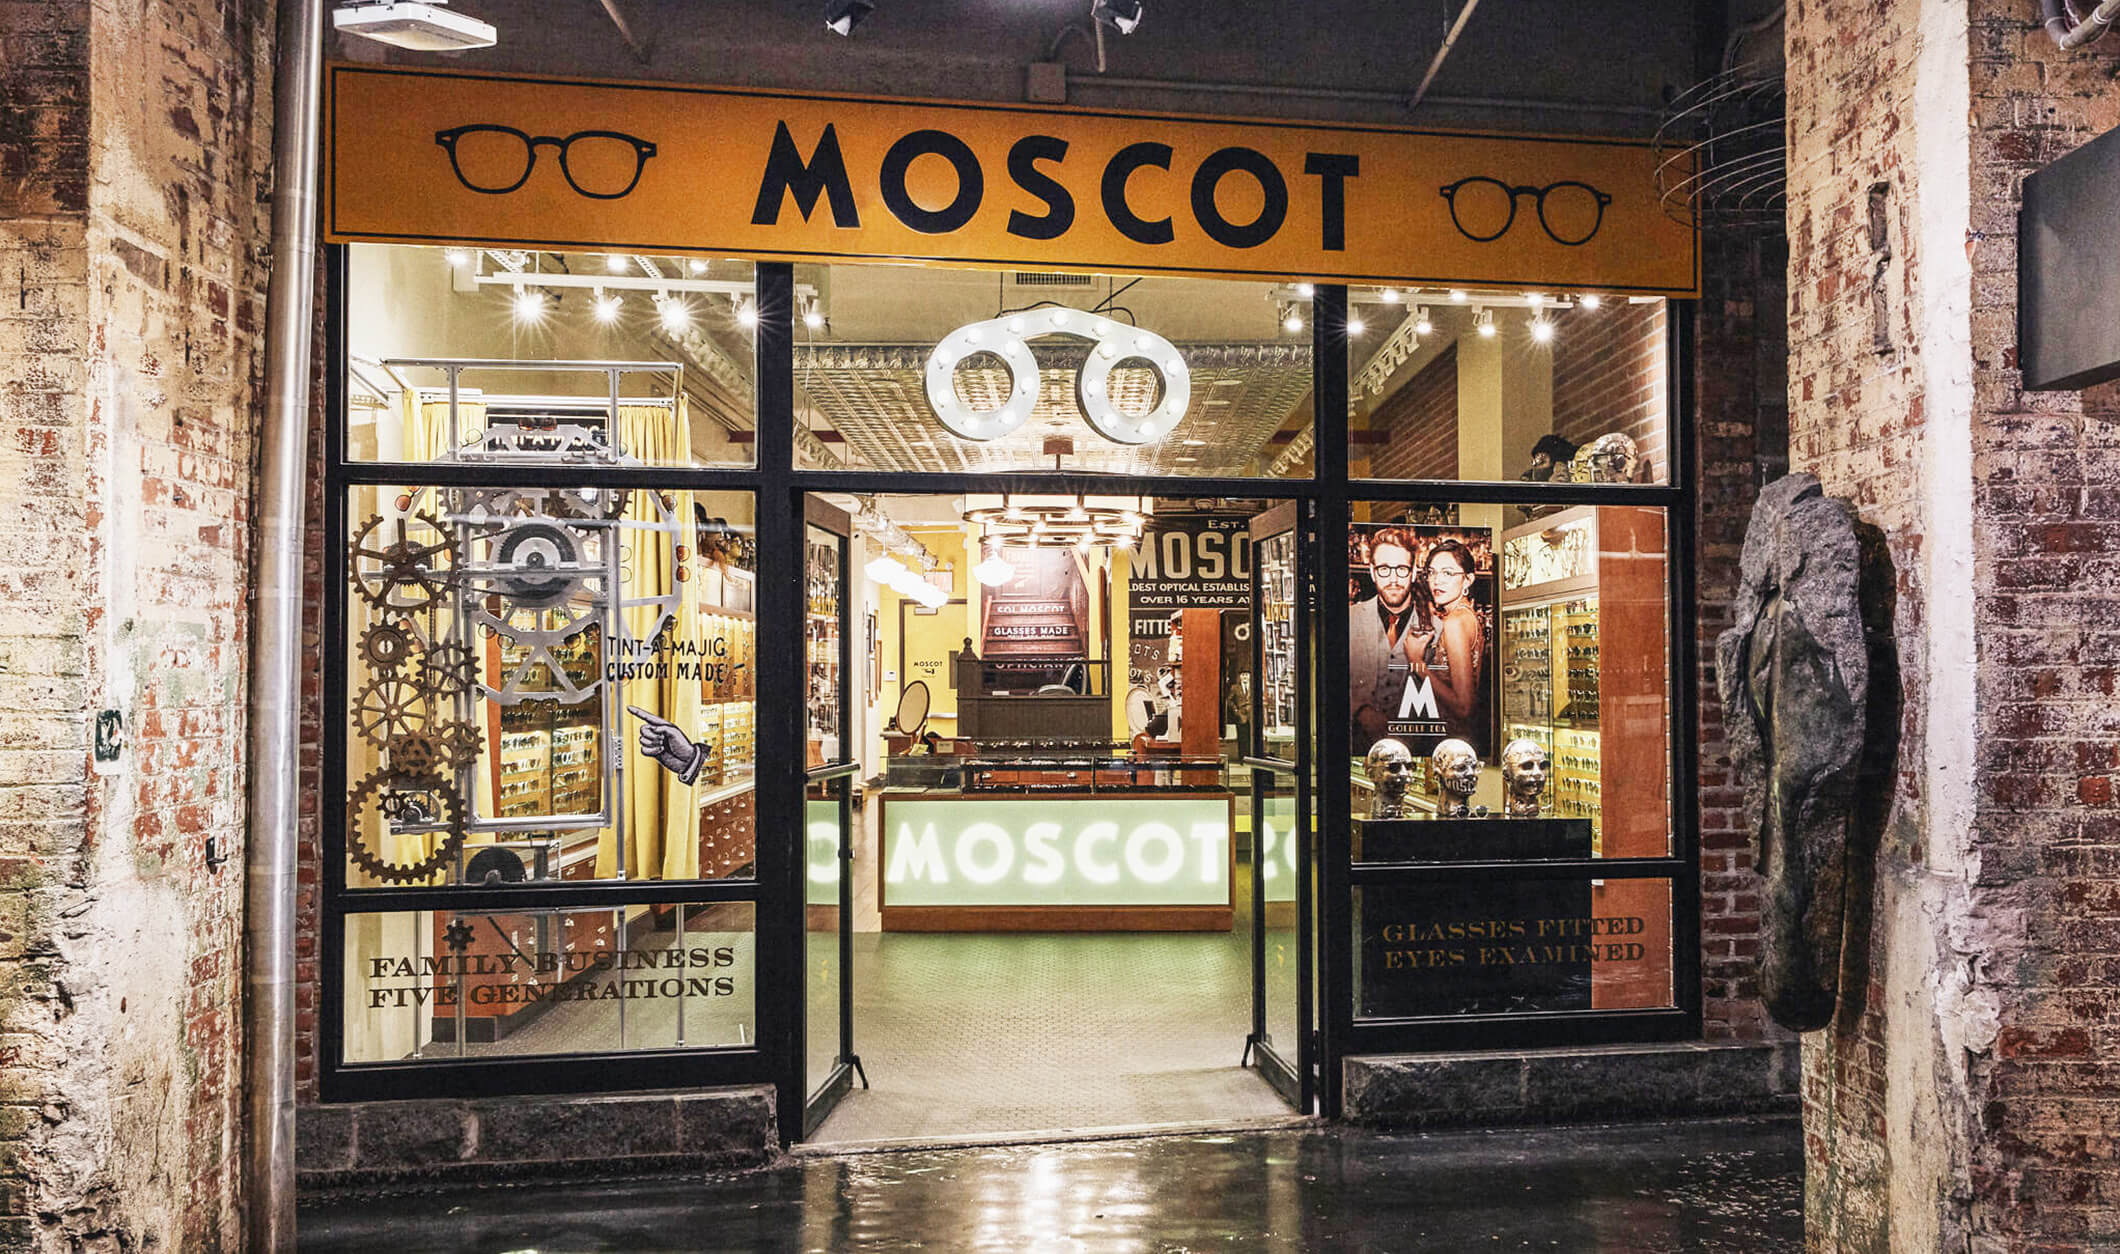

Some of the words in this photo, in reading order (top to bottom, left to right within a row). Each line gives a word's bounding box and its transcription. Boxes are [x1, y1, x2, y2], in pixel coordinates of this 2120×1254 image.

[751, 119, 1359, 251] MOSCOT
[1140, 596, 1173, 604] OVER
[1176, 595, 1188, 604] 16
[1191, 596, 1234, 604] YEARS
[1159, 583, 1200, 592] OPTICAL
[994, 626, 1036, 636] GLASSES
[1040, 626, 1068, 635] MADE
[607, 636, 726, 657] TINT-A-MAJIG
[606, 662, 668, 682] CUSTOM
[676, 662, 727, 683] MADE
[913, 660, 943, 668] MOSCOT
[1397, 675, 1440, 718] M
[885, 820, 1229, 884] MOSCOT
[1382, 919, 1526, 943] GLASSES
[1537, 916, 1645, 938] FITTED
[369, 953, 523, 978] FAMILY
[532, 946, 735, 974] BUSINESS
[1384, 948, 1465, 969] EYES
[1478, 942, 1646, 966] EXAMINED
[368, 985, 458, 1008] FIVE
[470, 976, 735, 1006] GENERATIONS
